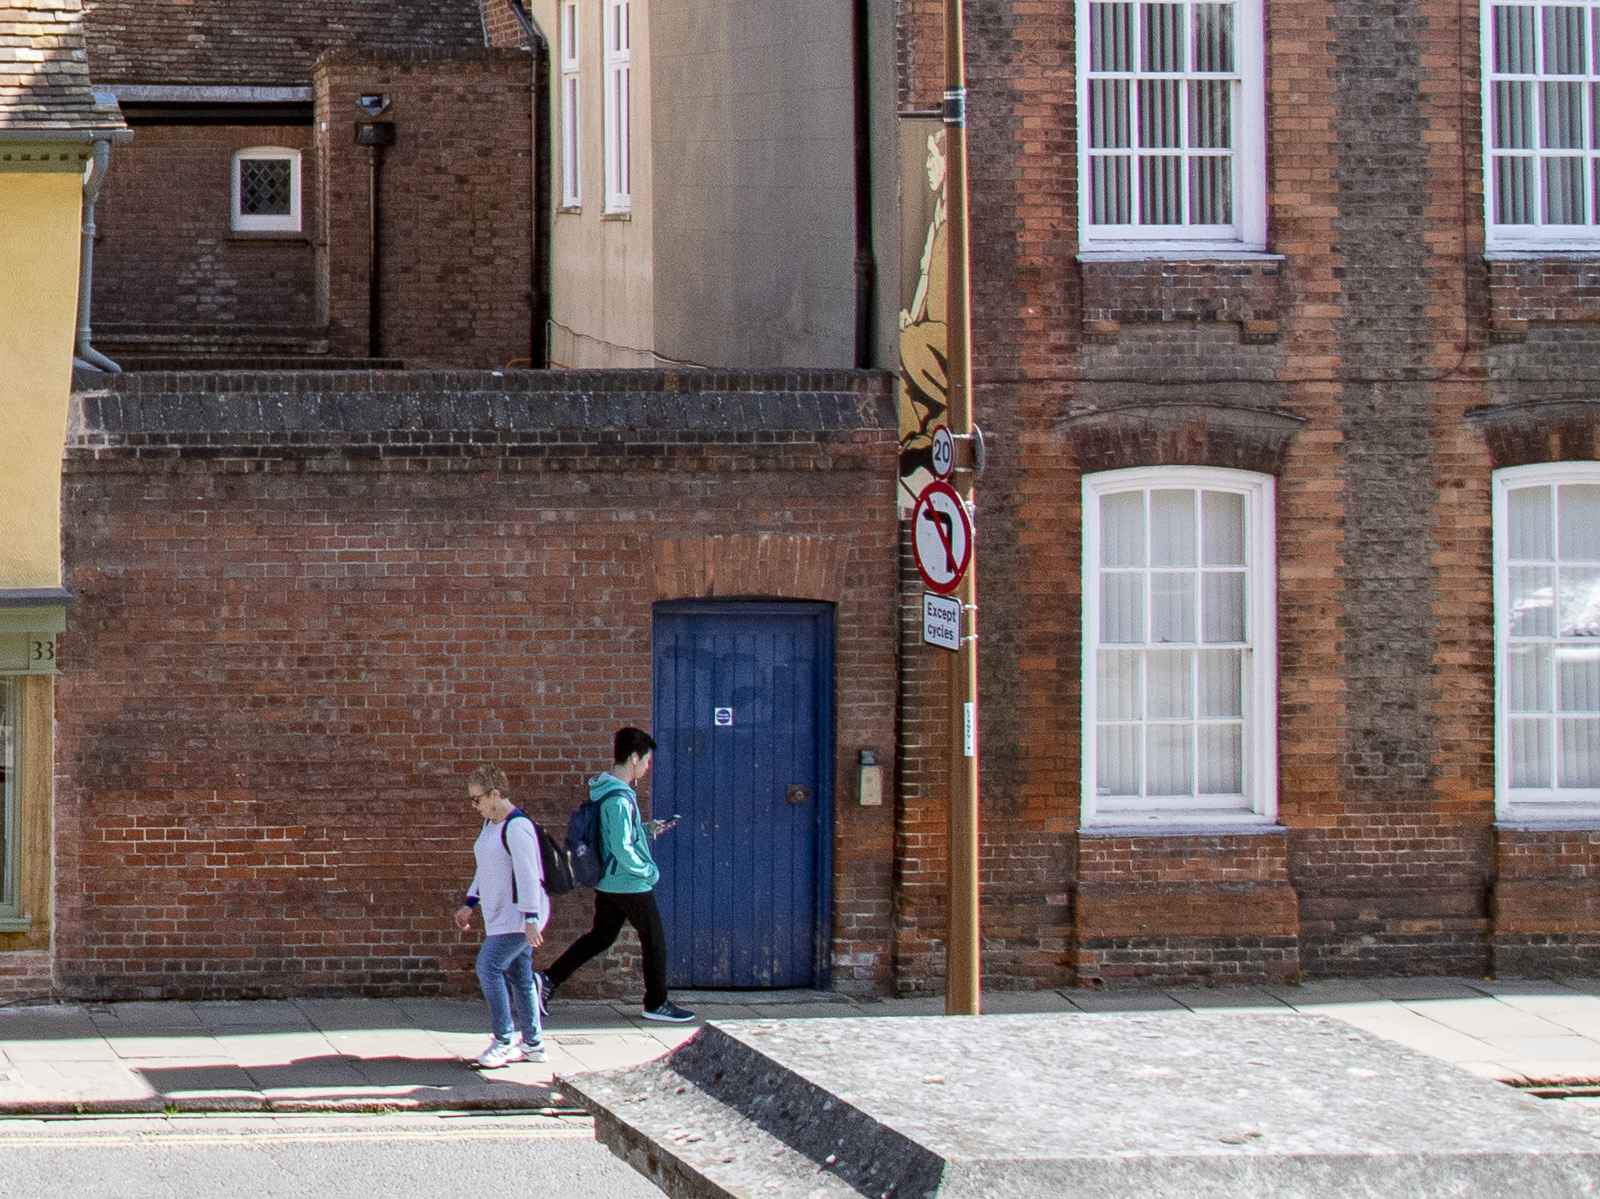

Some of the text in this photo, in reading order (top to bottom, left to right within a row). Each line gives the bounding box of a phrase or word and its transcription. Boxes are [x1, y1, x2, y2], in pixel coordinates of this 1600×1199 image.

[934, 439, 950, 463] 20
[927, 601, 957, 623] Except
[927, 623, 954, 641] cycles
[31, 641, 55, 660] 33
